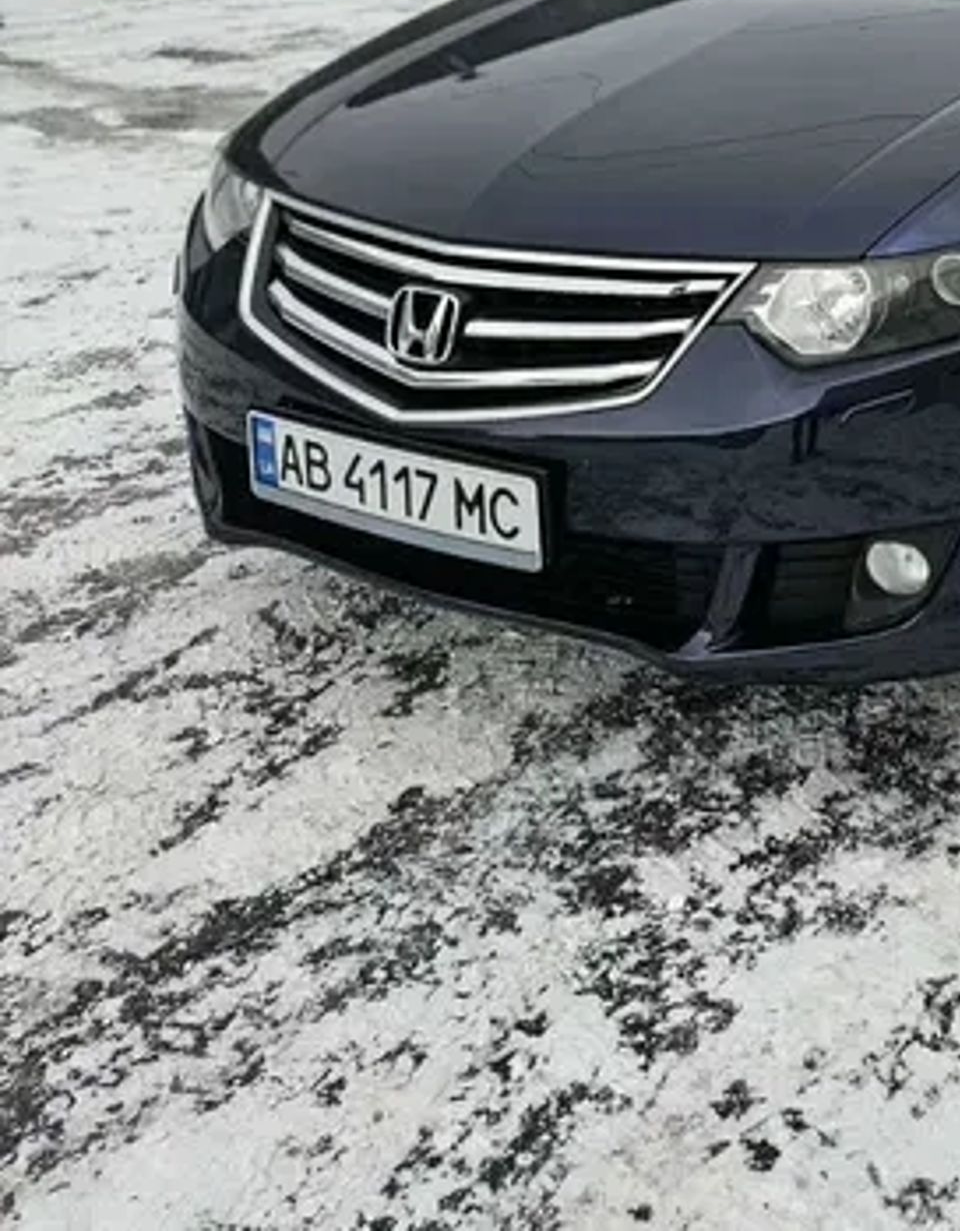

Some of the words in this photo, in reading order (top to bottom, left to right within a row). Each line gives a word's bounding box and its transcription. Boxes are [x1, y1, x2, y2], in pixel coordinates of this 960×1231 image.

[281, 434, 332, 492] AB
[344, 452, 437, 521] 4117
[454, 476, 519, 540] MC
